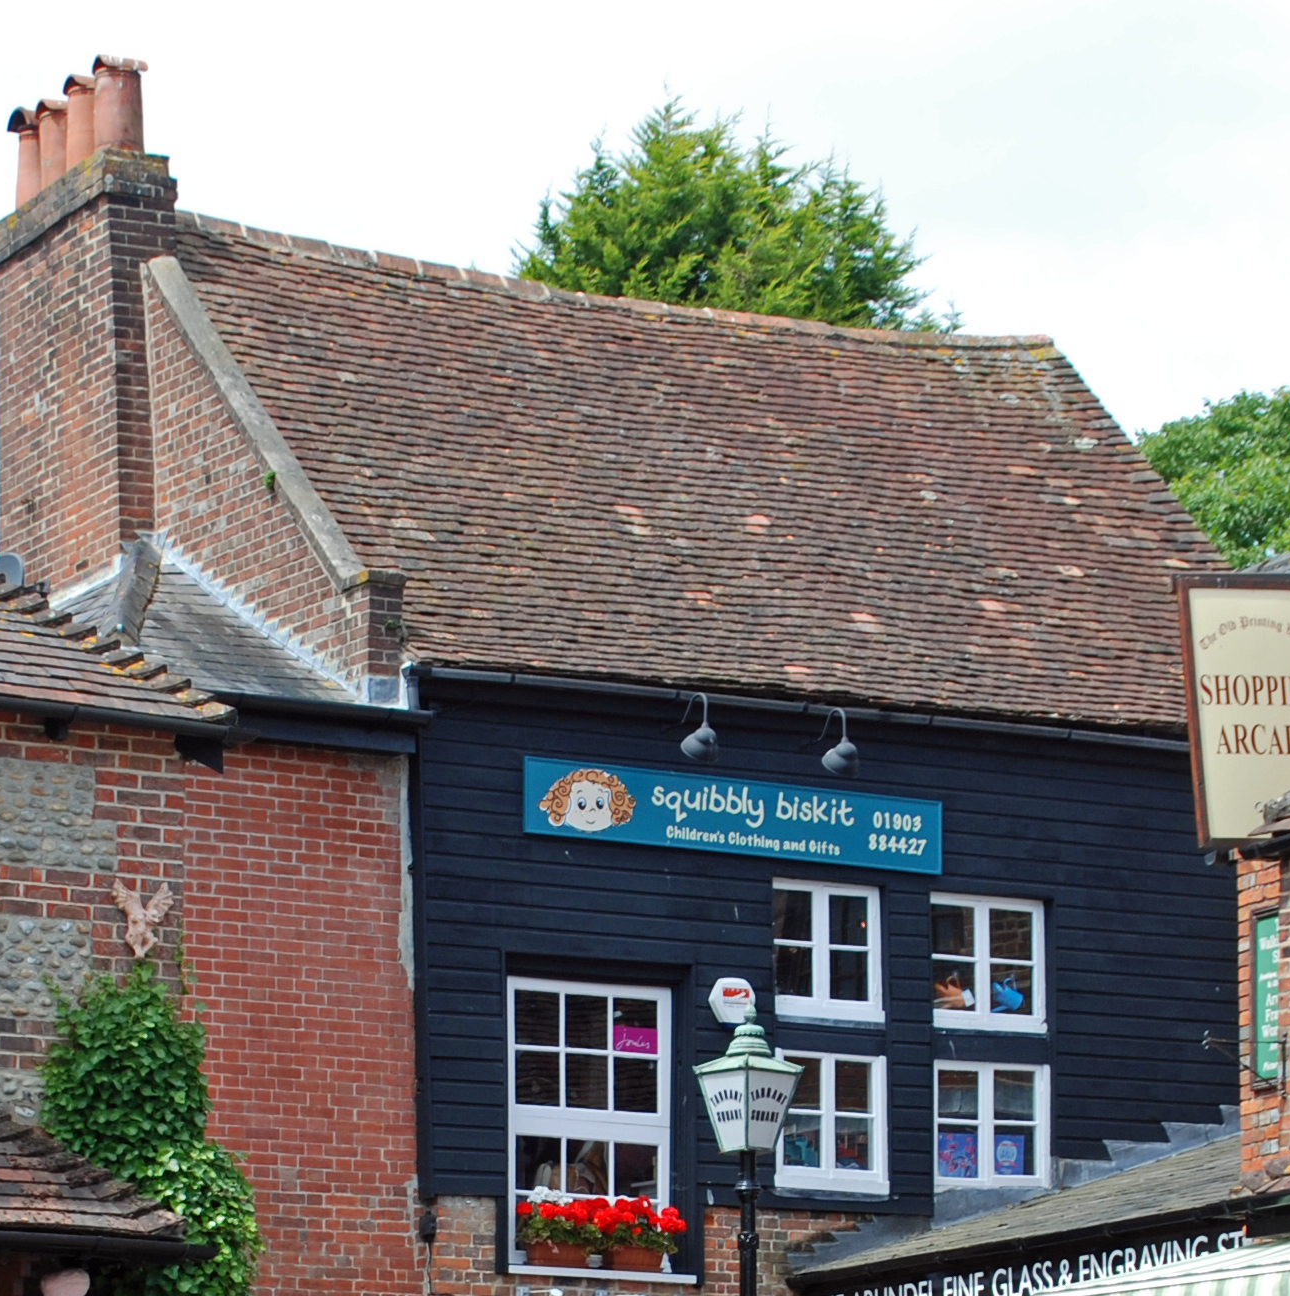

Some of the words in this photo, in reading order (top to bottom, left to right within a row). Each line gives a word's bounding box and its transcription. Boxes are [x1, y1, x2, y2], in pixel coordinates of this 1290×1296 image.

[1199, 632, 1218, 650] The
[651, 784, 765, 829] squibbly
[775, 791, 856, 827] biskit
[872, 810, 923, 833] 01903
[665, 824, 726, 847] Children's
[727, 830, 781, 852] Clothing
[782, 838, 806, 853] and
[807, 839, 841, 857] Gifts
[868, 832, 928, 857] 884427
[716, 1109, 743, 1122] SQUARE
[750, 1109, 779, 1123] SQUARE
[1058, 1258, 1073, 1289] &
[1078, 1234, 1210, 1283] ENGRAVING
